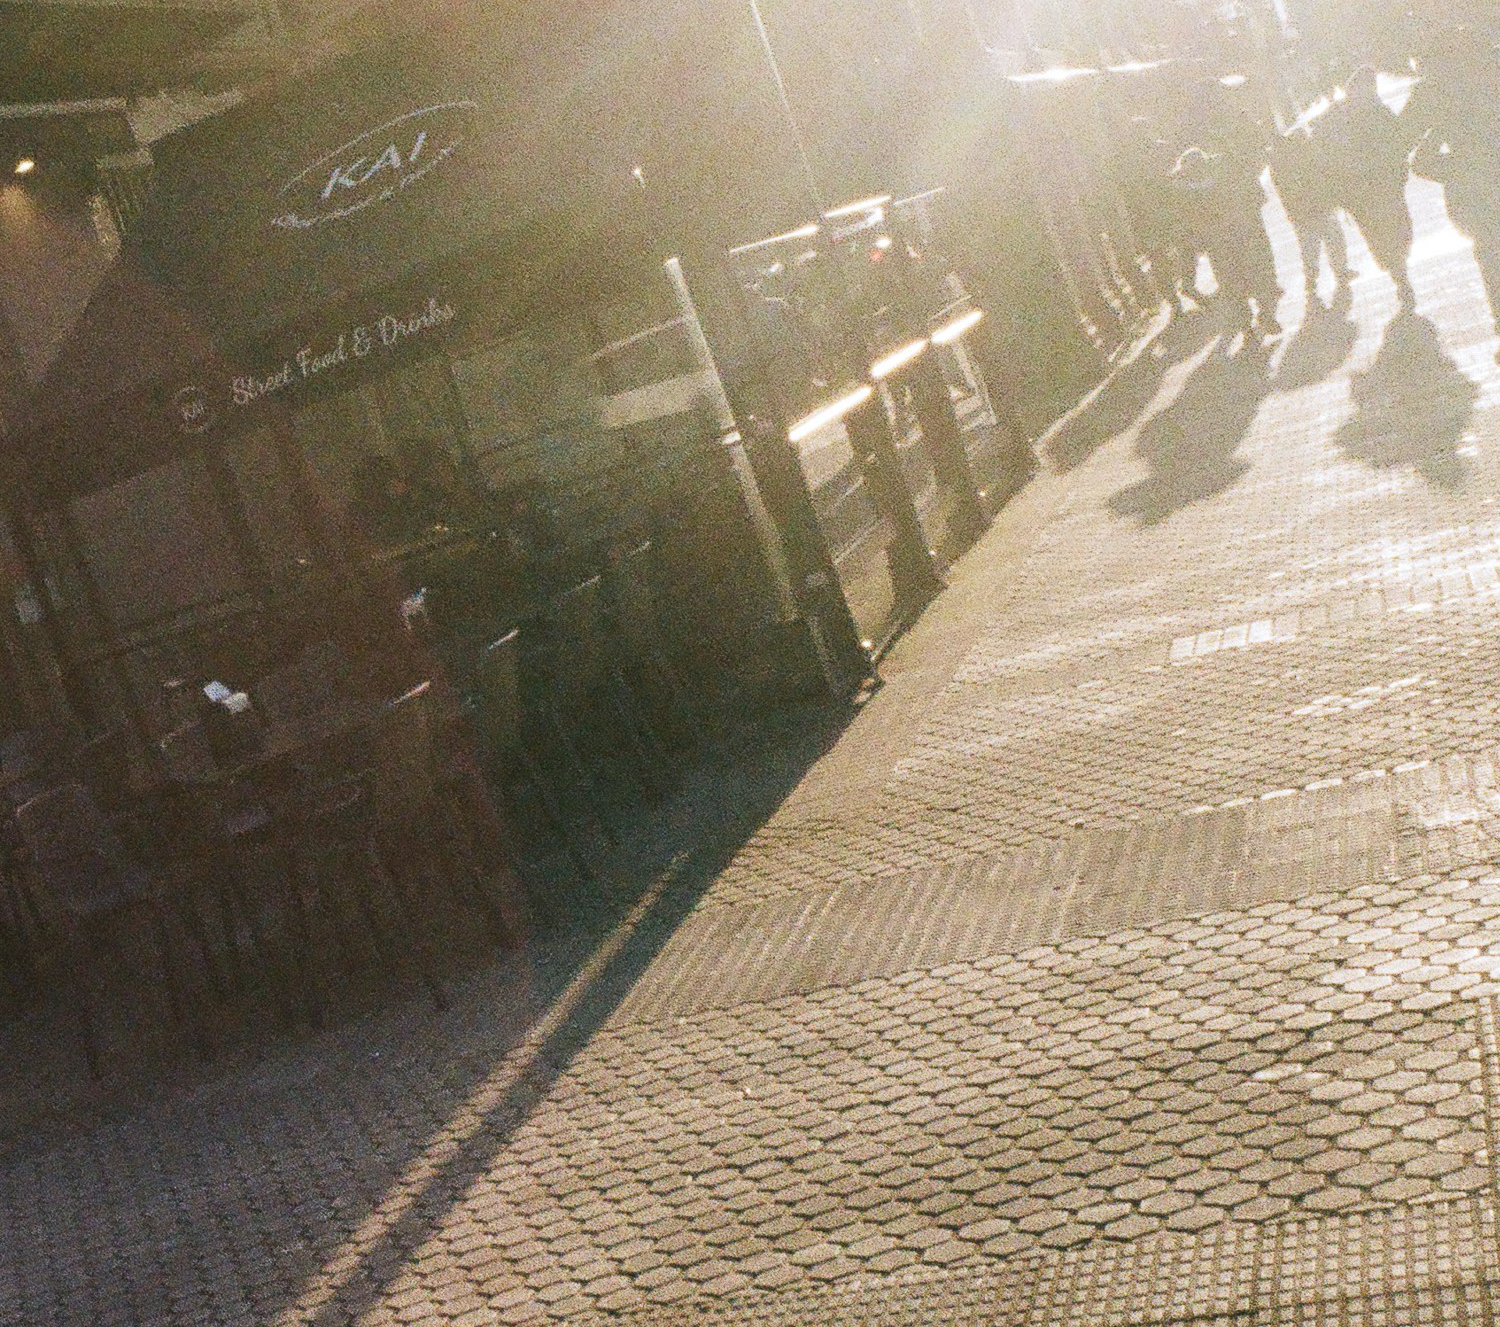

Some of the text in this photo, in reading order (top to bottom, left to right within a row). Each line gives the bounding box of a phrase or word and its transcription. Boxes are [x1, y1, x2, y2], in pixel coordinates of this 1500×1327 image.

[319, 131, 428, 200] KAI
[231, 297, 456, 405] Street Food & Drinks
